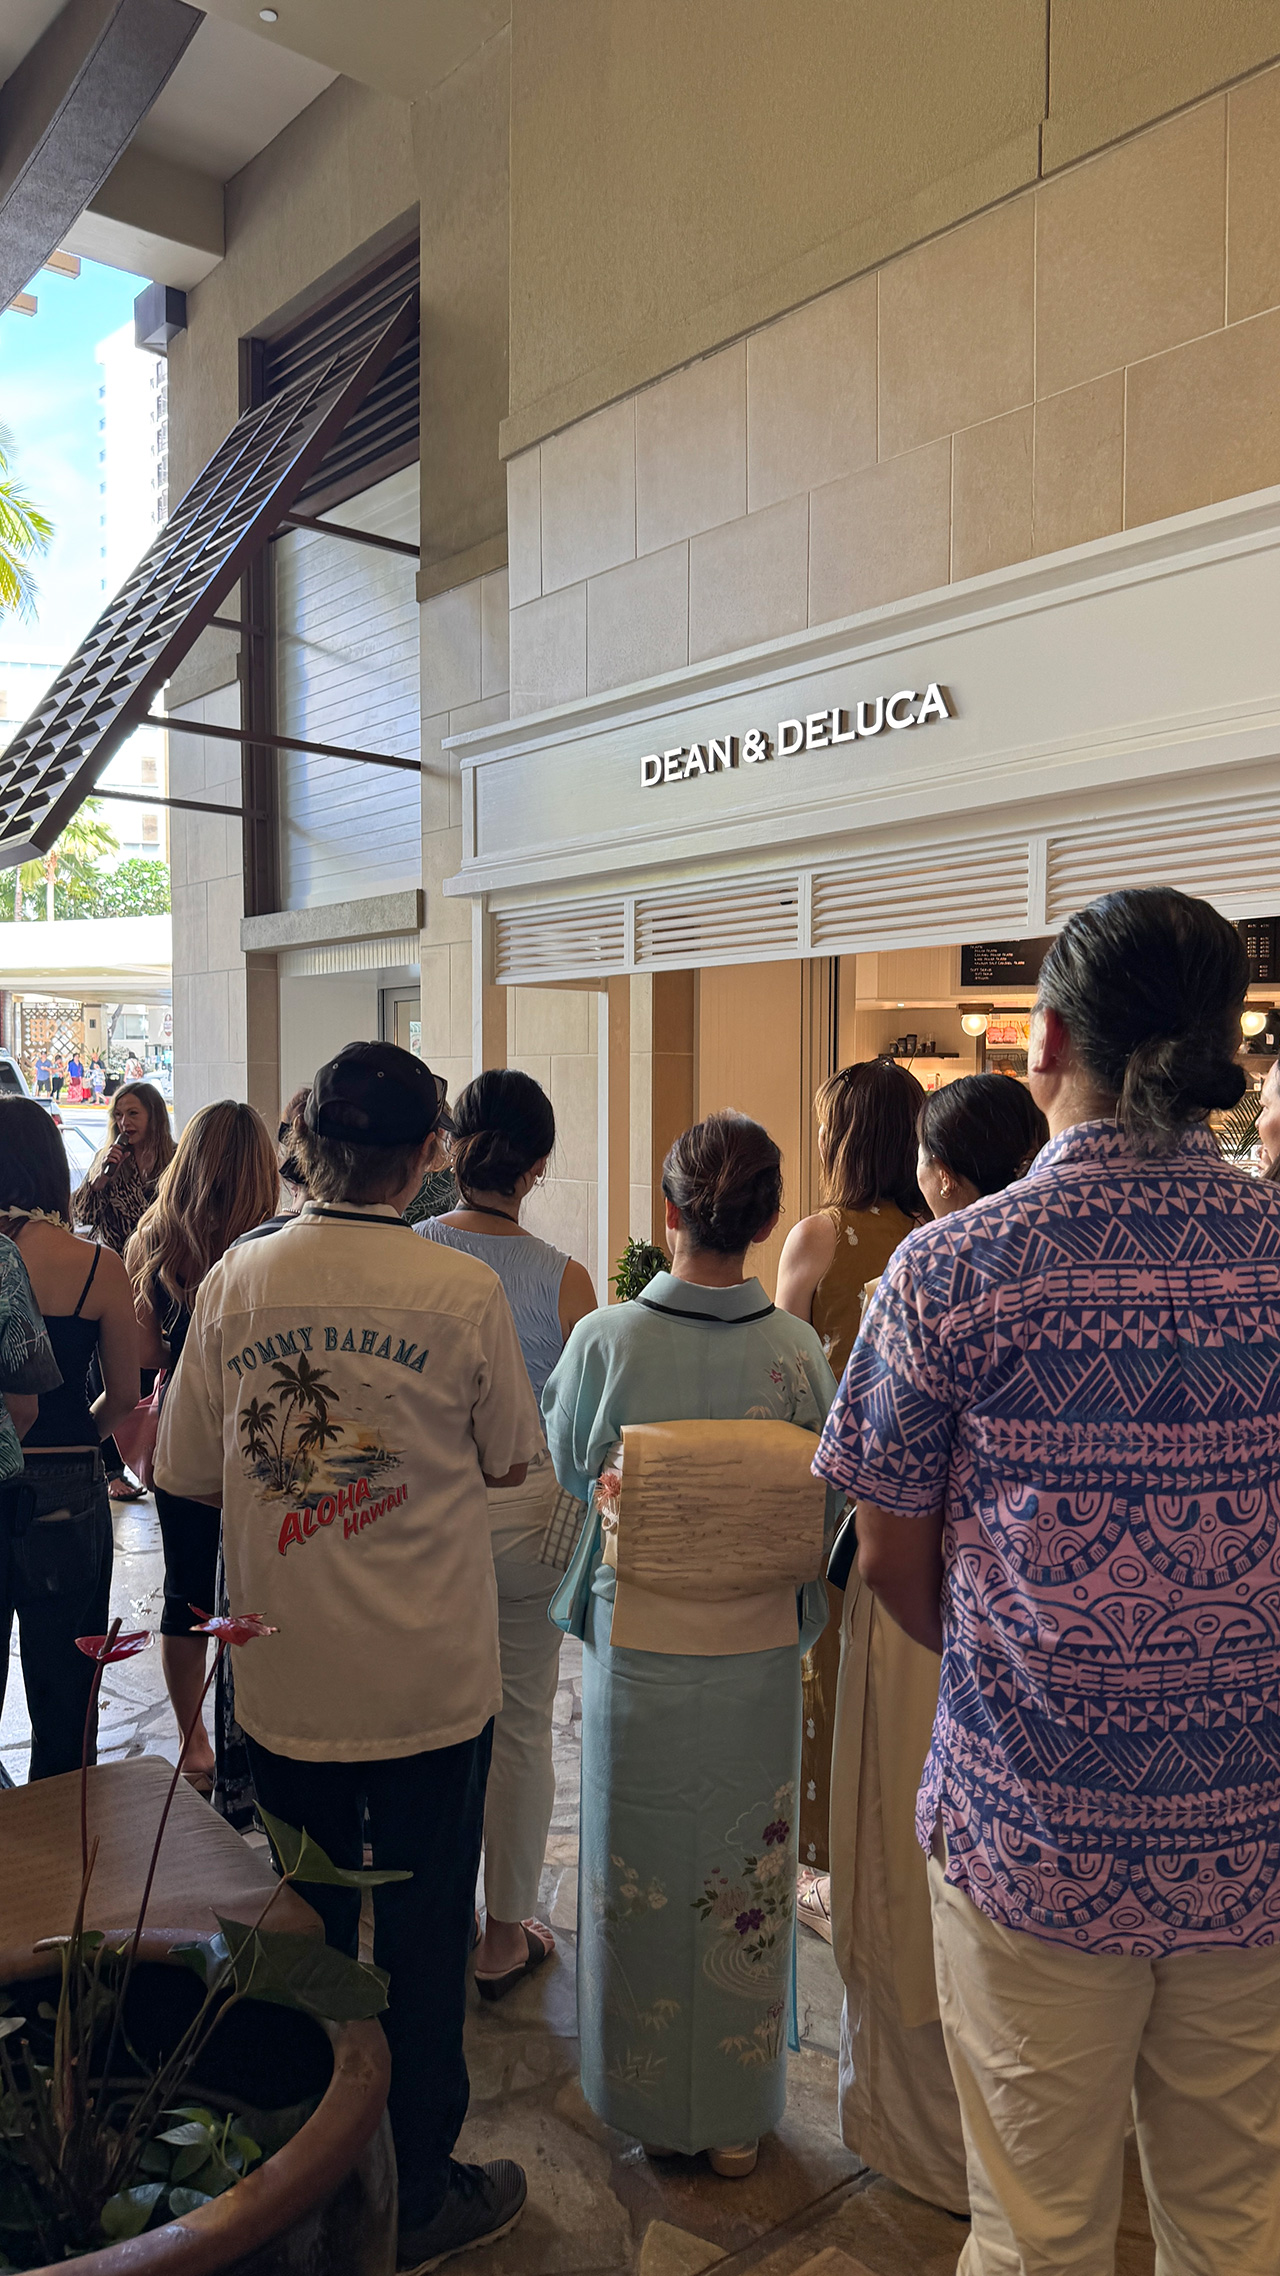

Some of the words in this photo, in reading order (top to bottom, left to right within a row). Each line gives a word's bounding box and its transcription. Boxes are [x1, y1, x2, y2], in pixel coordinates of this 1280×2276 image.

[640, 735, 734, 787] DEAN
[742, 728, 767, 762] &
[777, 683, 951, 756] DELUCA
[227, 1326, 314, 1379] TOMMY
[324, 1327, 430, 1374] BAHAMA
[278, 1477, 372, 1556] ALOHA
[342, 1483, 408, 1540] HAWAII
